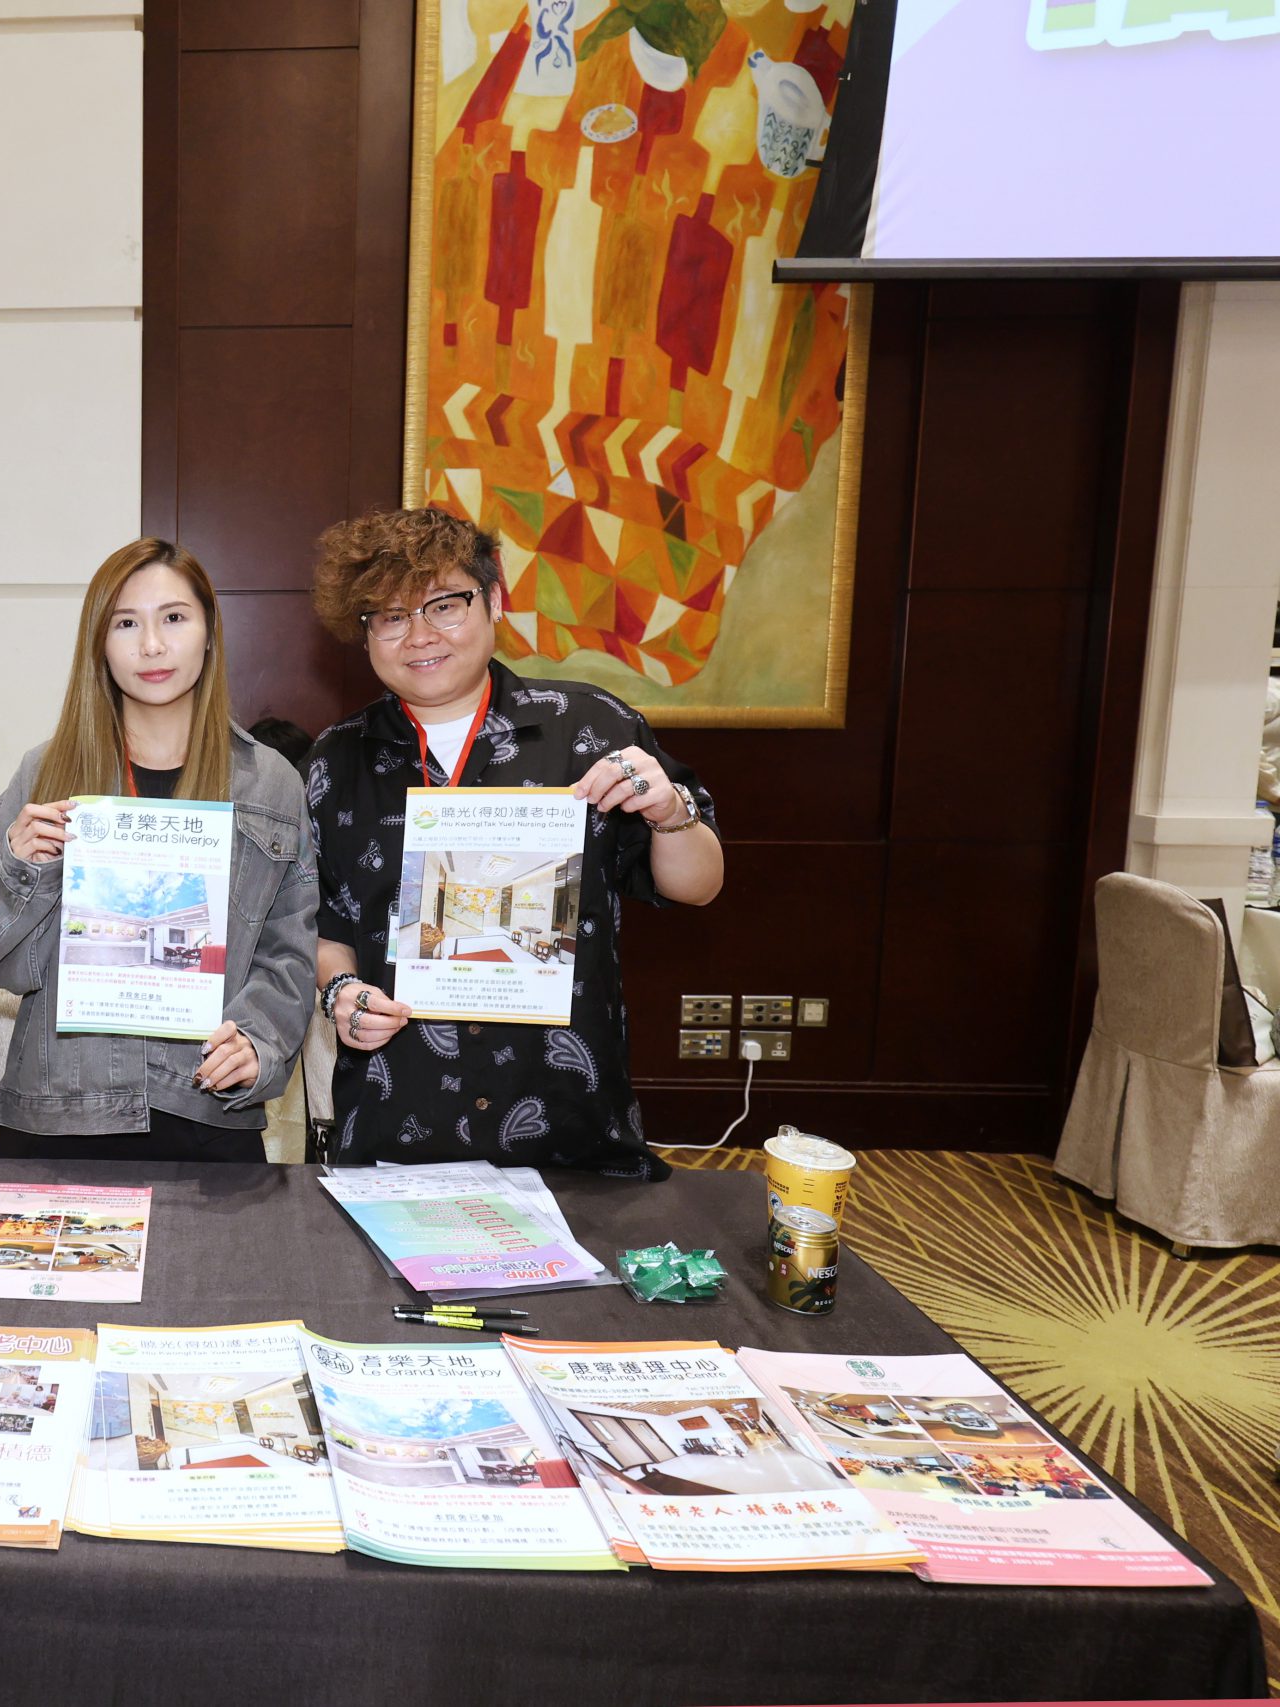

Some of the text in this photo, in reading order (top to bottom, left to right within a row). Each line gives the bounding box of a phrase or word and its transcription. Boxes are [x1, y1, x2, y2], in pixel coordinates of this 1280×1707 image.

[115, 812, 204, 834] 耆樂天地
[113, 830, 220, 848] Le Grand Silverjoy
[505, 1260, 567, 1280] JUMP
[357, 1354, 476, 1368] 耆樂天地
[361, 1367, 502, 1378] Le Grand Silverjoy
[575, 1373, 609, 1382] Hong
[610, 1373, 635, 1382] Ling
[637, 1372, 685, 1382] Nursing
